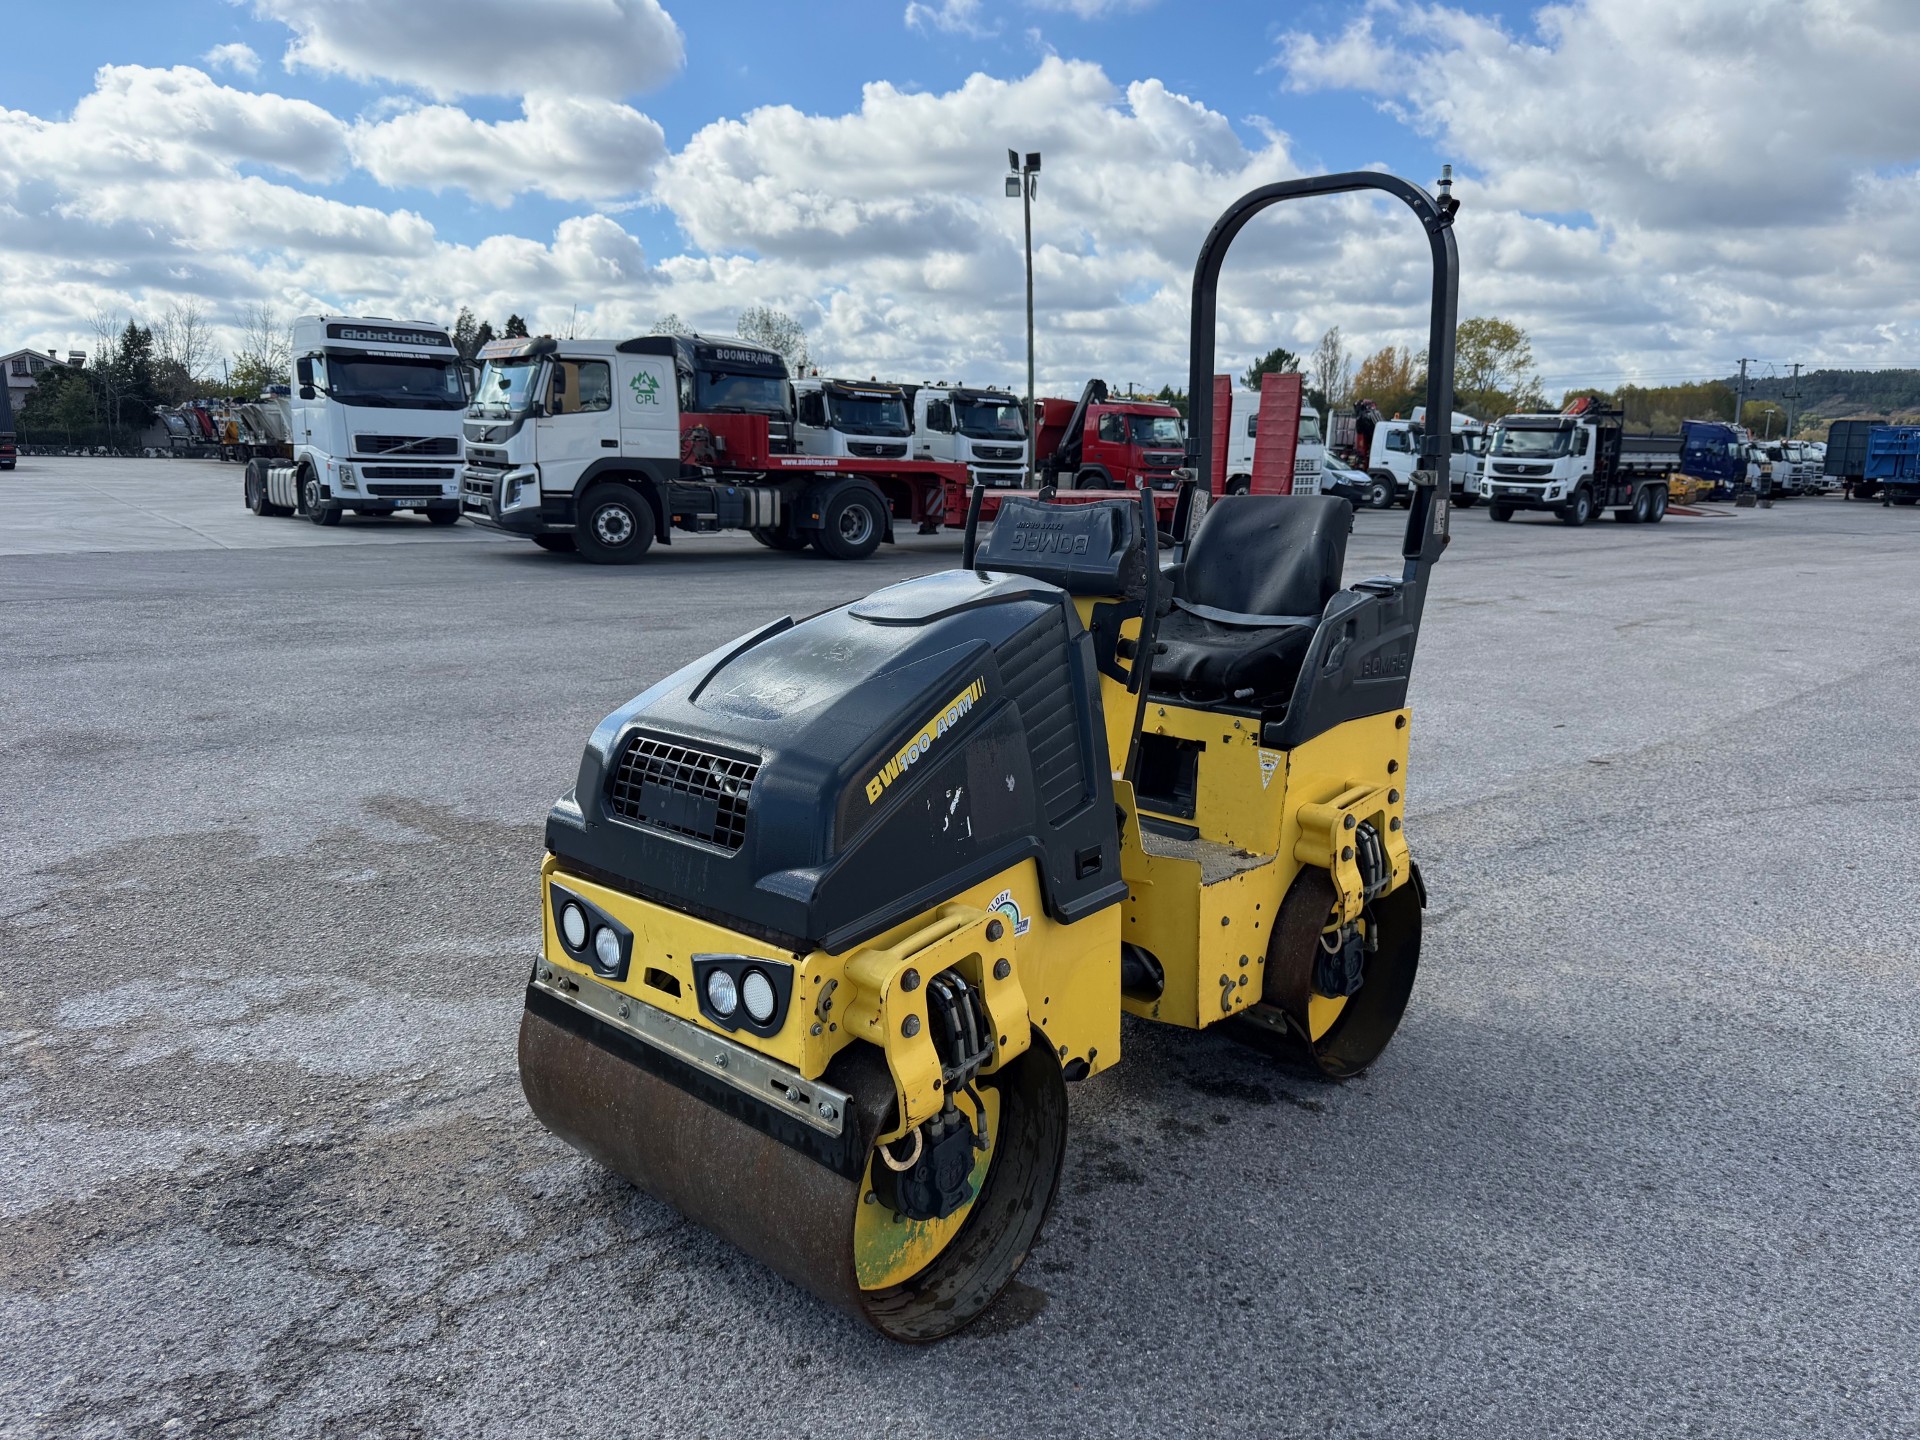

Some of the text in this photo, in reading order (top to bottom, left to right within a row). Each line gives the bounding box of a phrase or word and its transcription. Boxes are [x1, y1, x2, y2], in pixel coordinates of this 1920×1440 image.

[340, 329, 442, 346] Globetrotter
[716, 349, 774, 365] BOOMERANG
[635, 393, 660, 405] CPL
[1016, 521, 1065, 531] FAYAT GROUP
[1010, 530, 1091, 556] BOMAG
[1361, 652, 1408, 677] BOMAG
[936, 693, 973, 739] ADM
